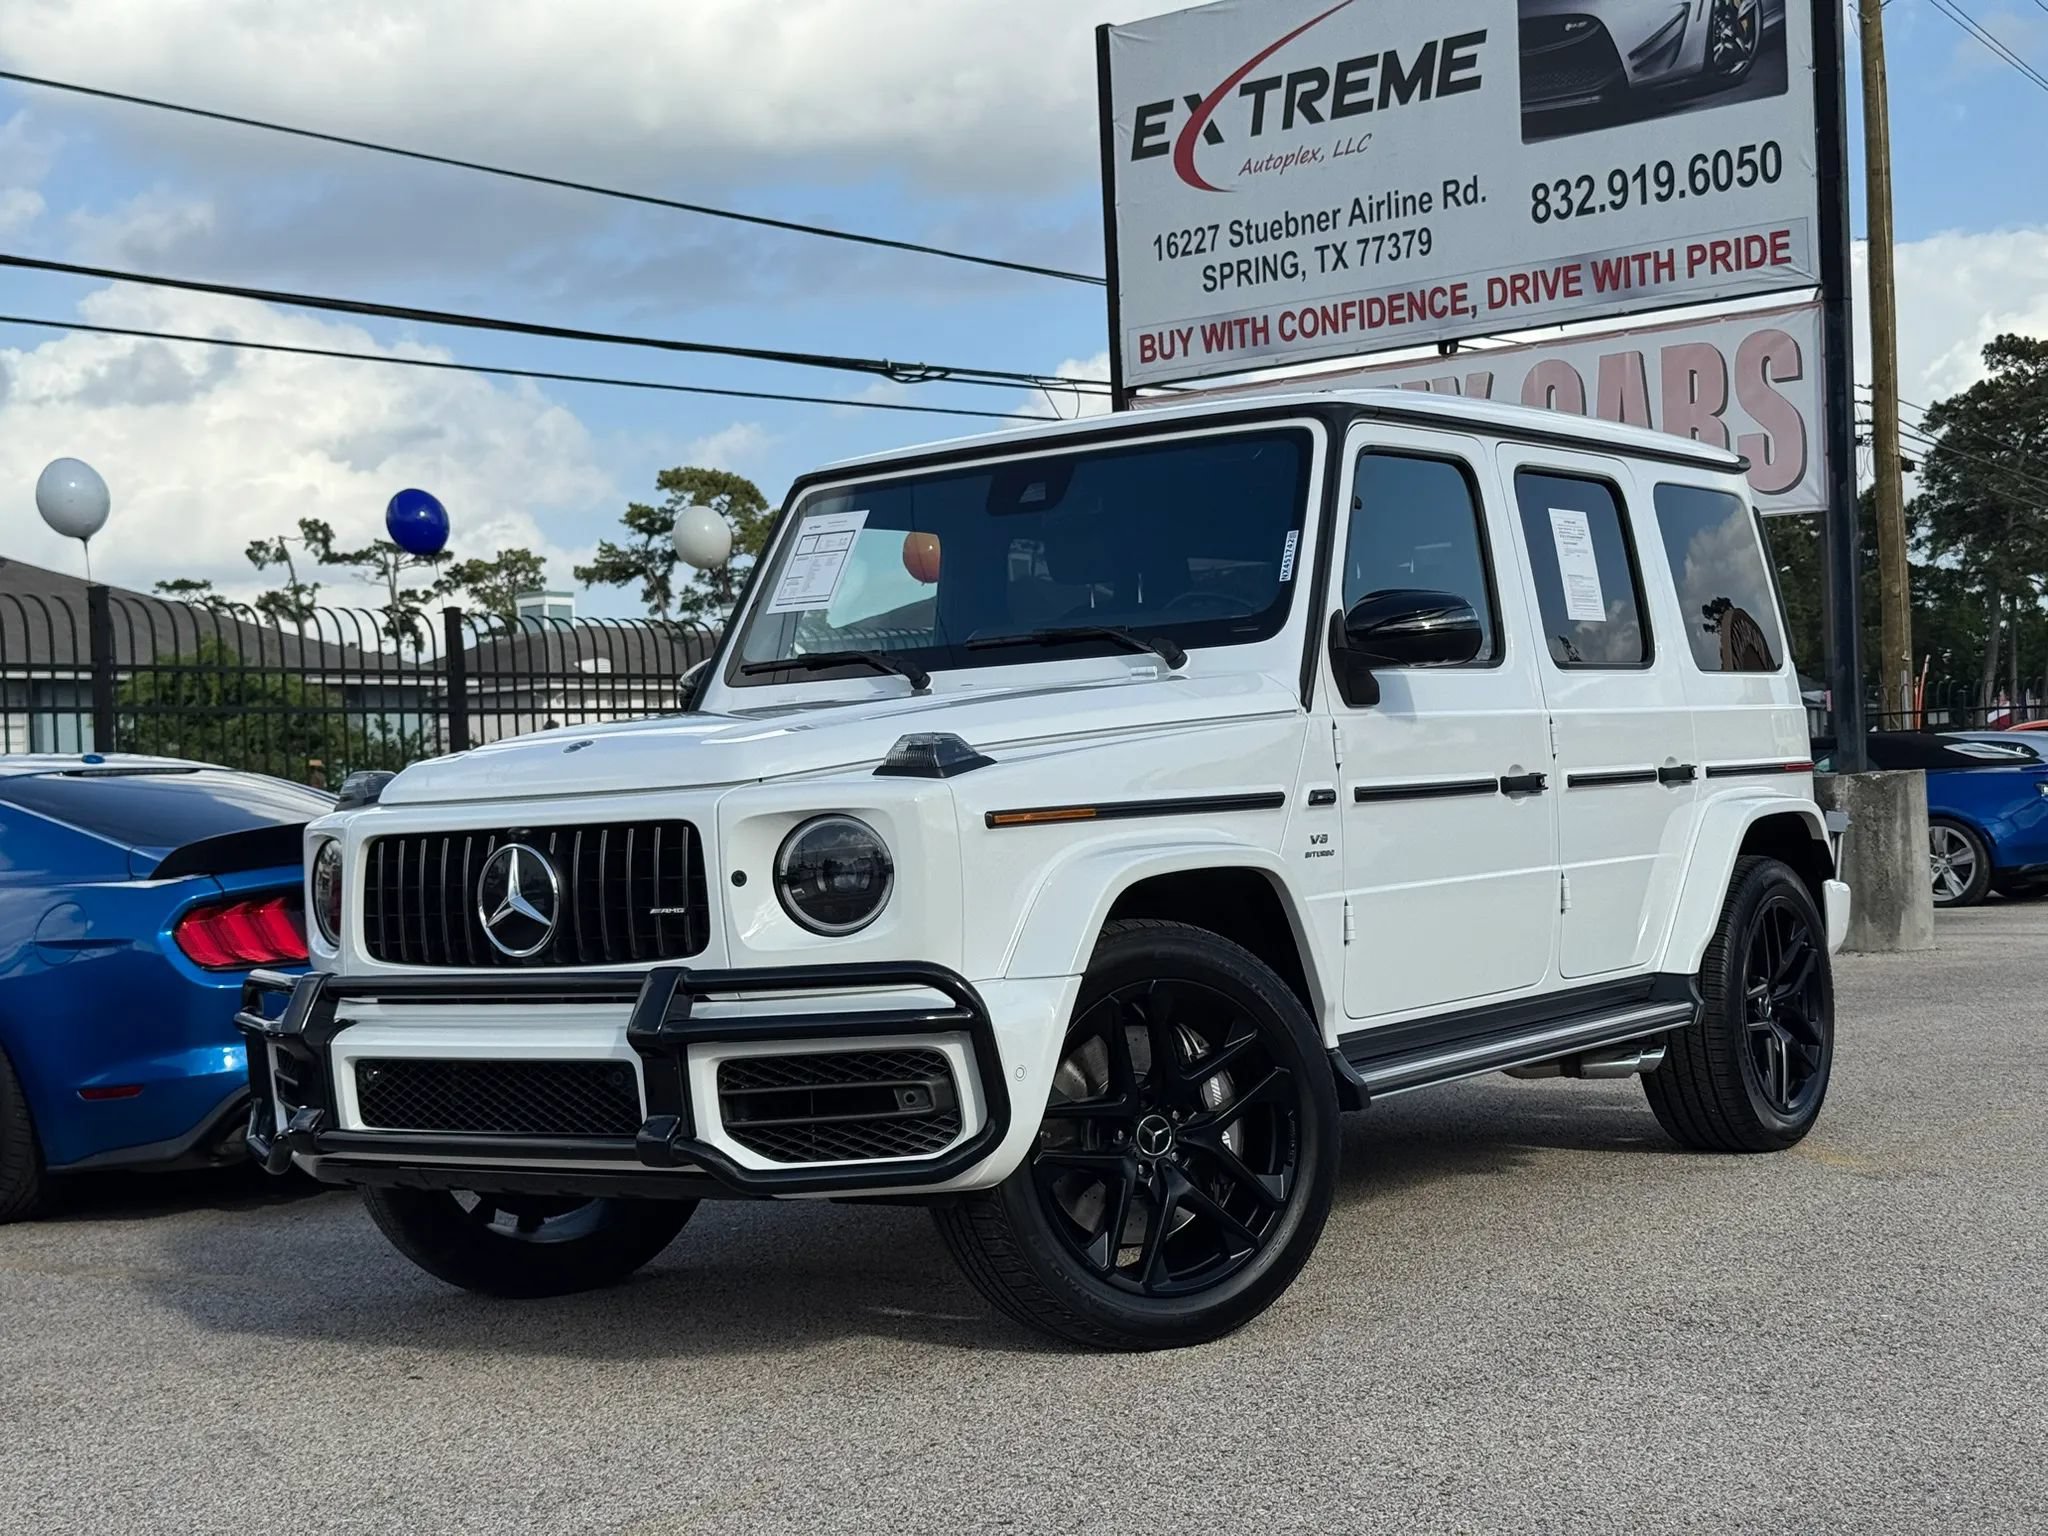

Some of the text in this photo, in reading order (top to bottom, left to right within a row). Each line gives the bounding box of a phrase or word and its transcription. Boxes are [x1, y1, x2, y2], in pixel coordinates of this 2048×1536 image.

[1131, 29, 1488, 161] EXTREME
[1238, 133, 1373, 177] Autoplex, LLC
[1531, 140, 1783, 224] 832.919.6050
[1153, 175, 1488, 262] 16227 Stuebner Airline Rd.
[1202, 227, 1433, 293] SPRING, TX 77379
[1139, 229, 1792, 364] BUY WITH CONFIDENCE, DRIVE WITH PRIDE
[1310, 834, 1328, 844] V8
